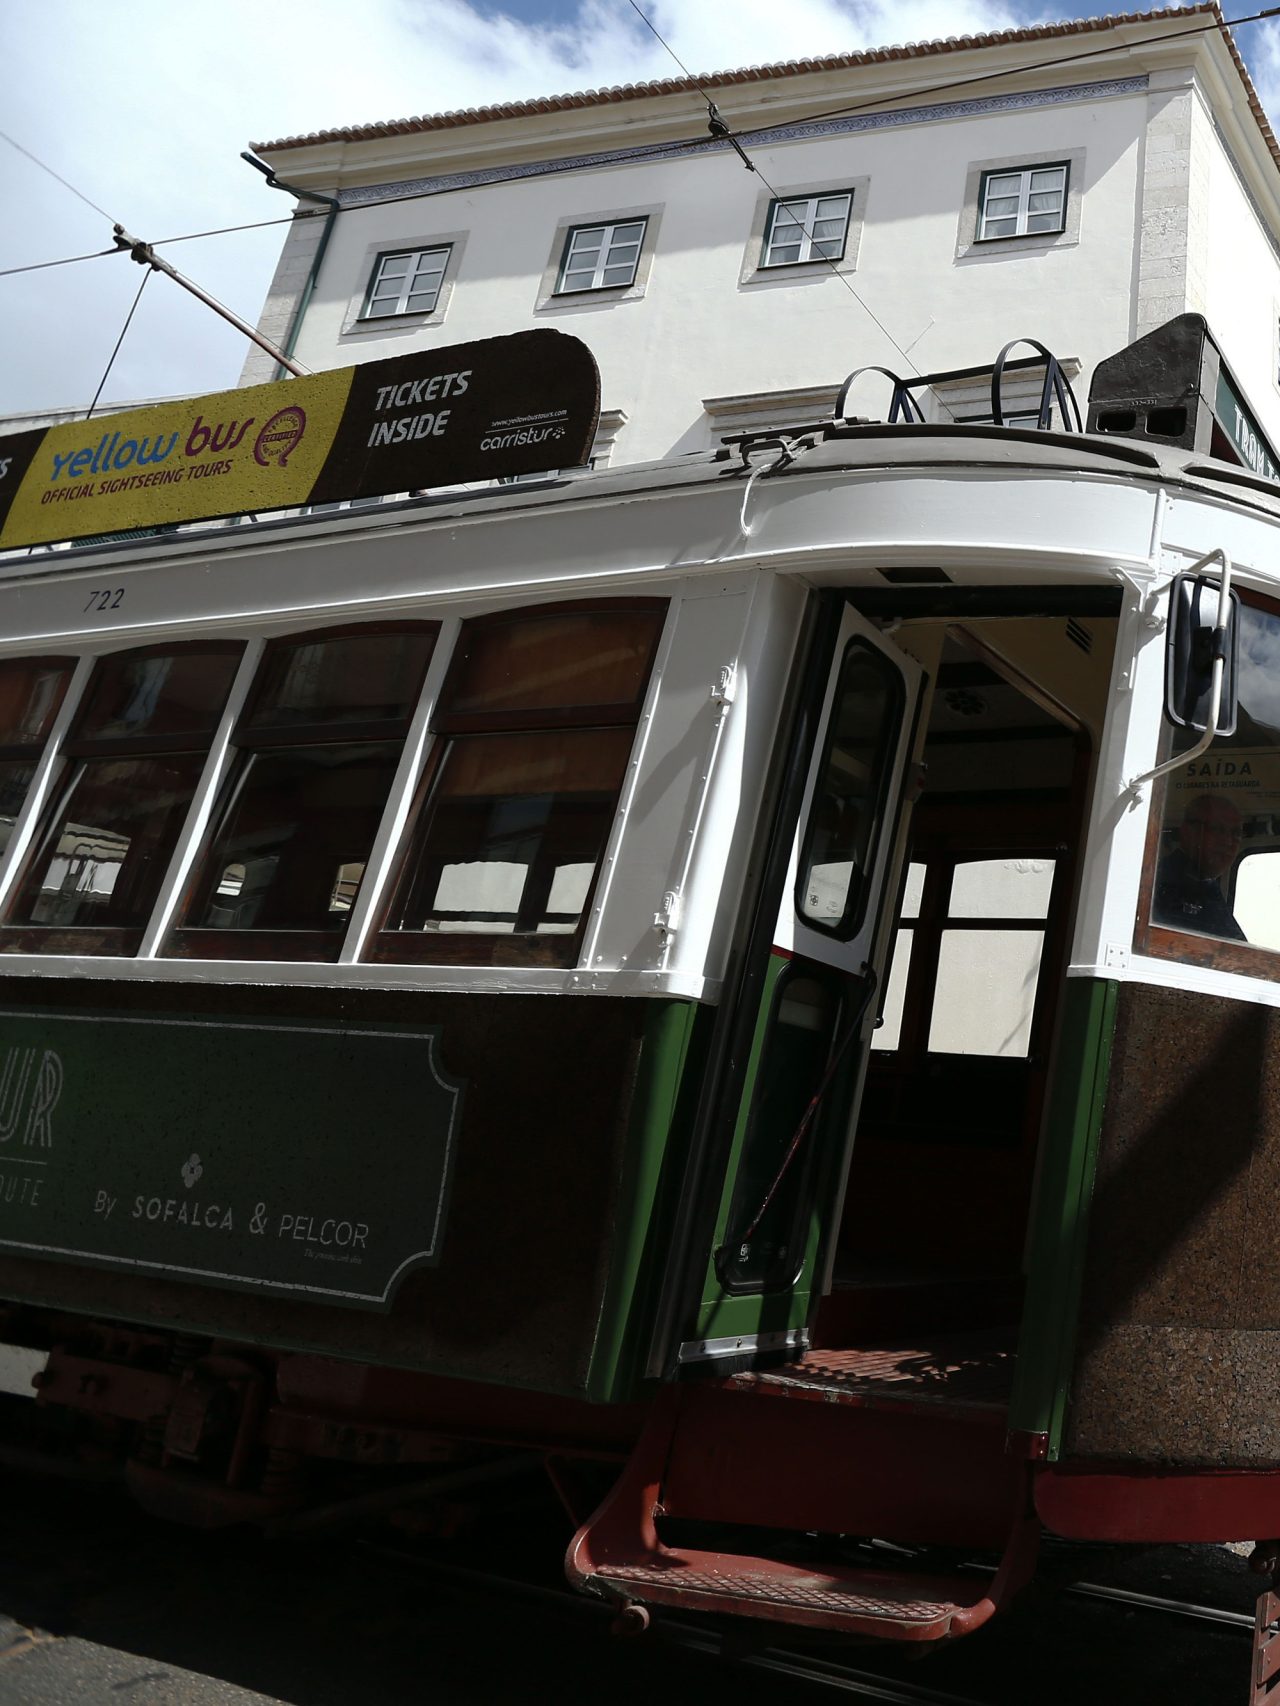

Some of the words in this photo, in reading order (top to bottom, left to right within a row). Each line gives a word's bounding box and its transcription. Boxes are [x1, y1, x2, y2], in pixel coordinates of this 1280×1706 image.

[375, 370, 472, 411] TICKETS
[185, 415, 256, 457] bus
[367, 410, 451, 447] INSIDE
[480, 427, 553, 451] carristur
[41, 483, 94, 505] OFFICIAL
[98, 468, 185, 495] SIGHTSEEING
[188, 459, 233, 481] TOURS
[83, 588, 125, 612] 722
[1187, 759, 1252, 777] SAÍDA
[94, 1190, 118, 1221] By
[131, 1195, 233, 1231] SOFALCA
[248, 1201, 268, 1235] &
[278, 1214, 368, 1248] PELCOR
